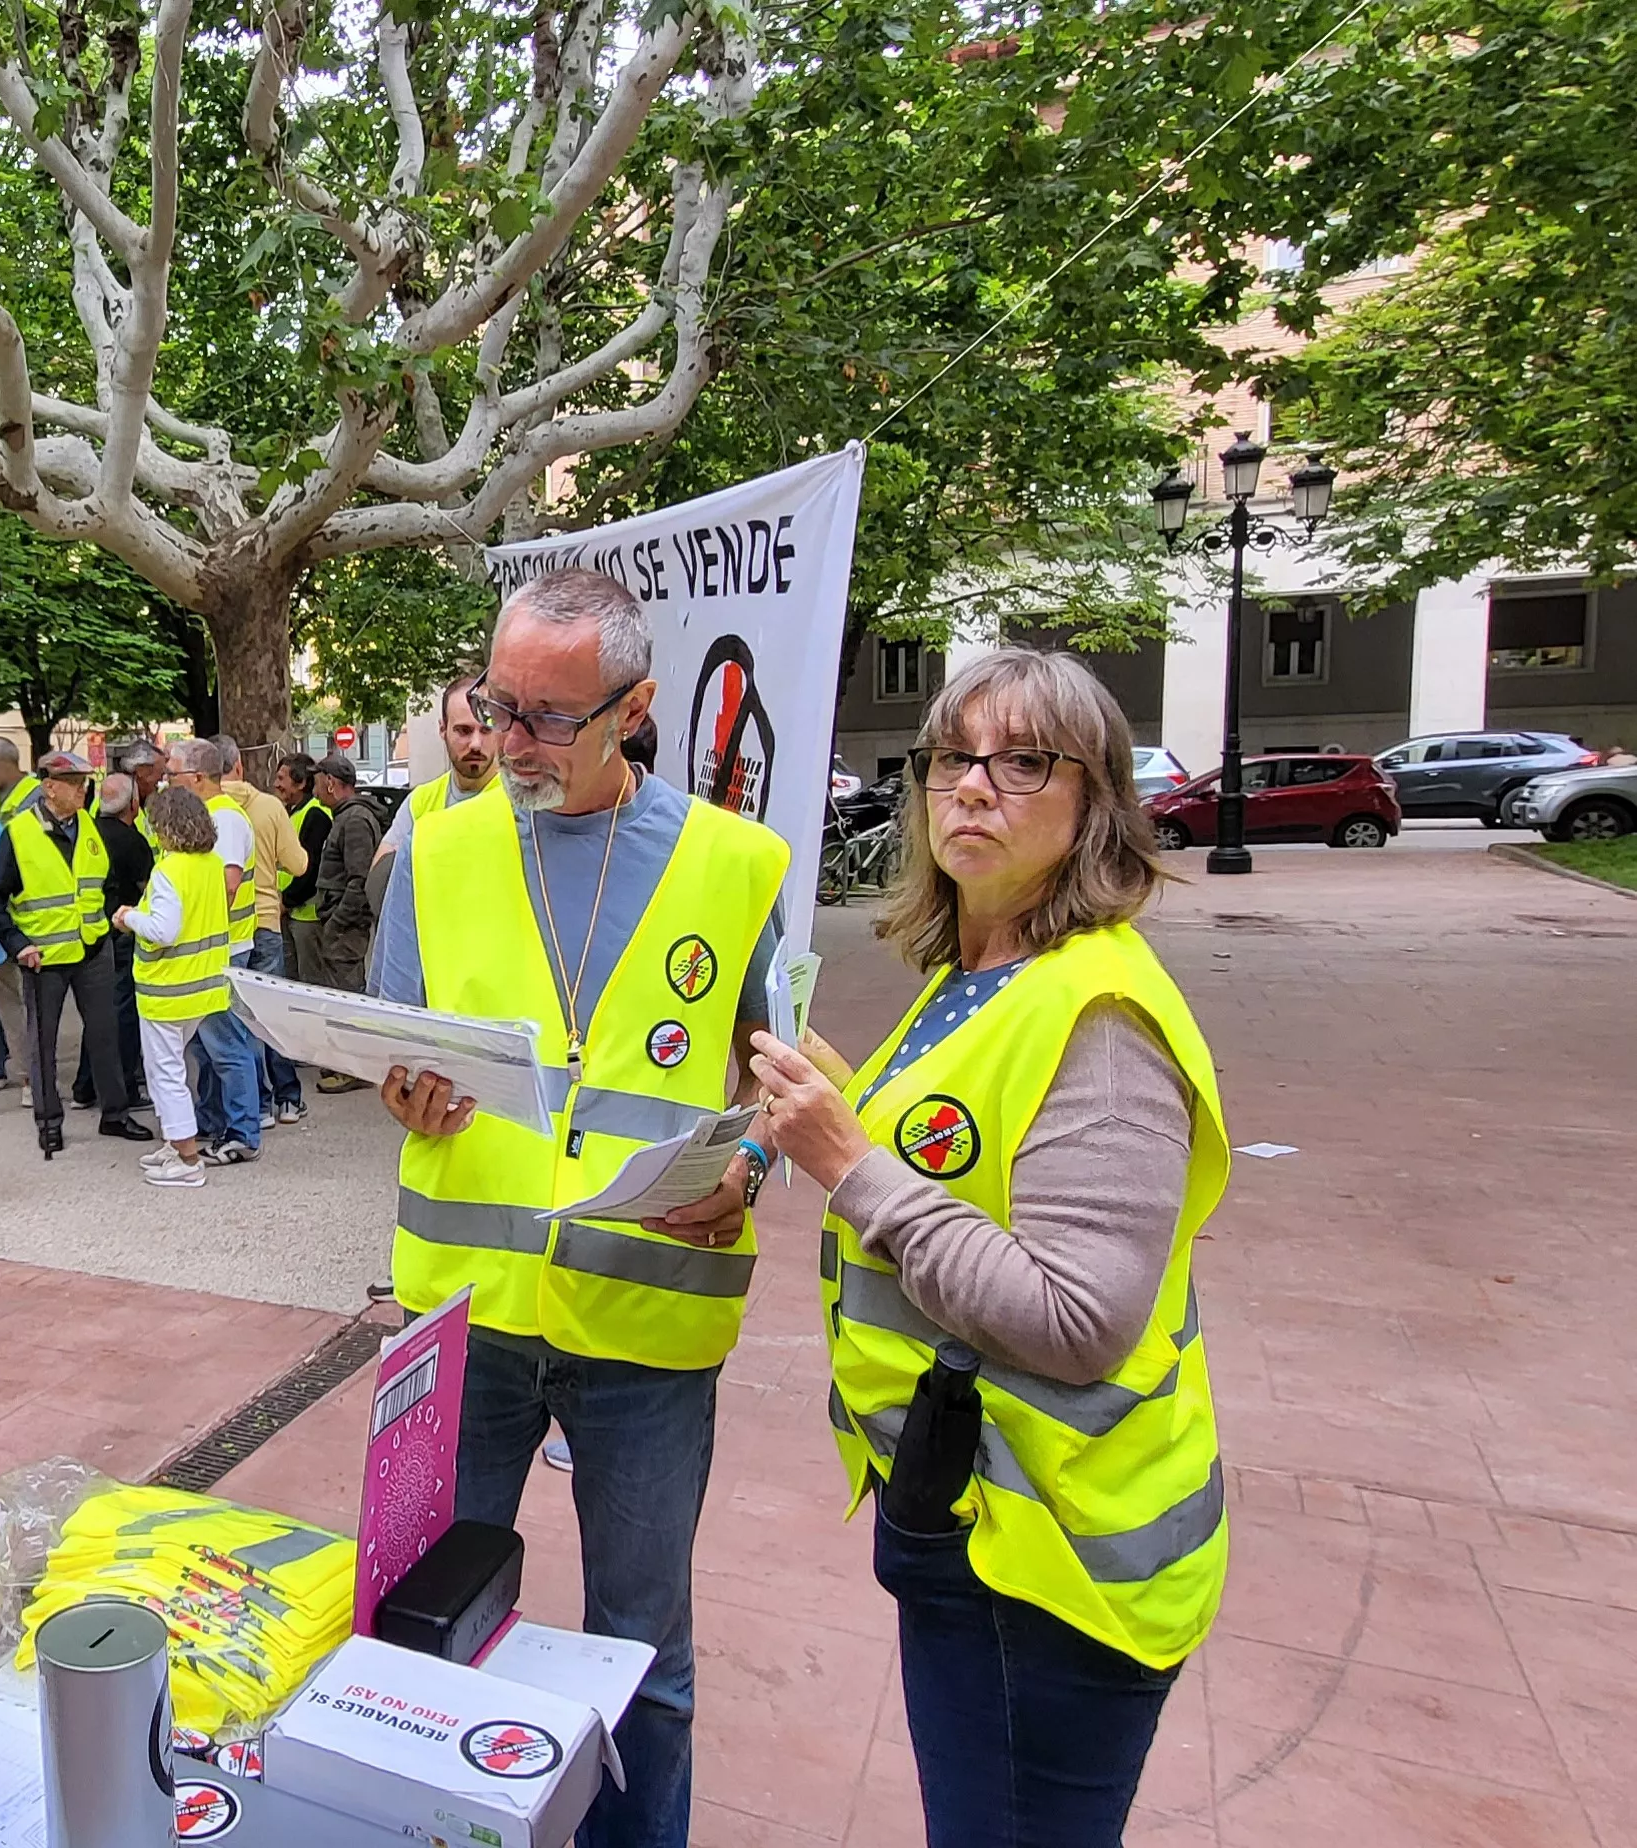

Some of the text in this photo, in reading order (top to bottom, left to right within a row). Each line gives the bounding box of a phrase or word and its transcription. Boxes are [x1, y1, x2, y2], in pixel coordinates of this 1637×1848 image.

[633, 537, 669, 602] SE
[672, 514, 796, 599] VENDE
[331, 1698, 450, 1743] RENOVABLES
[343, 1684, 460, 1728] PERO NO ASÍ
